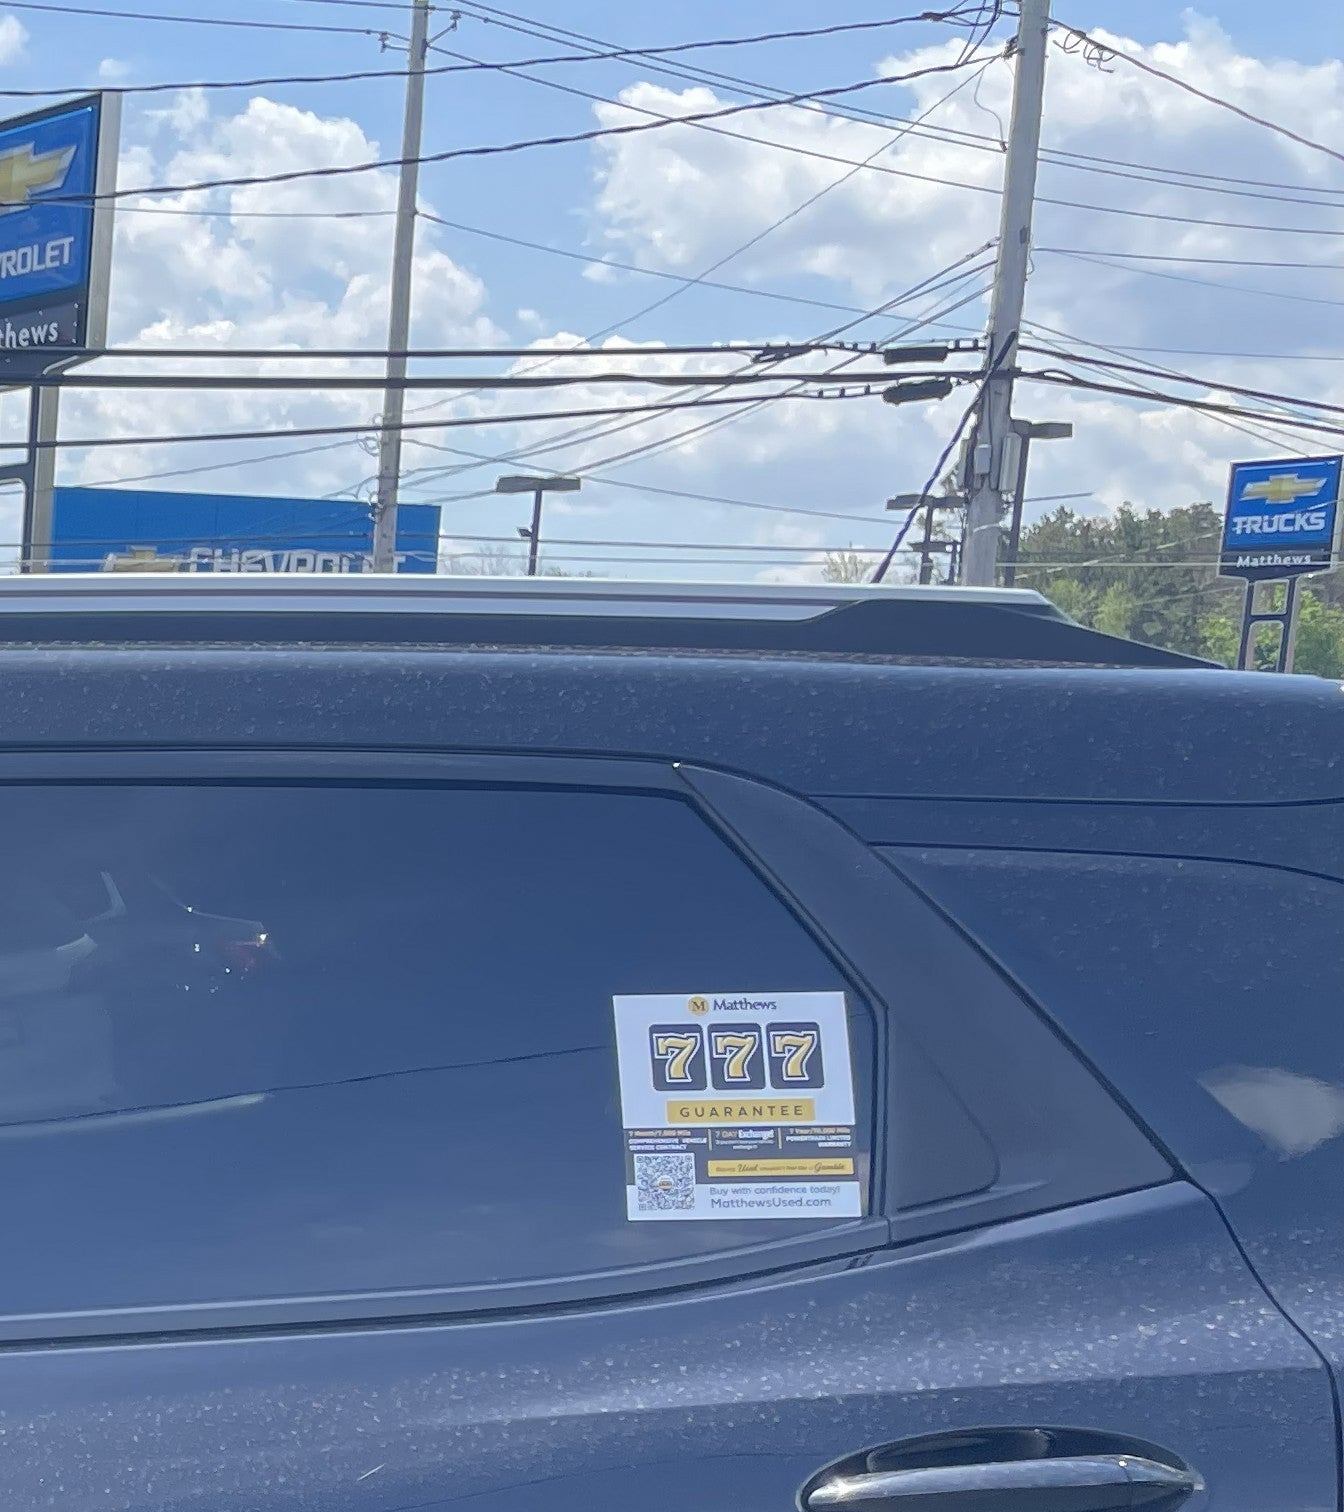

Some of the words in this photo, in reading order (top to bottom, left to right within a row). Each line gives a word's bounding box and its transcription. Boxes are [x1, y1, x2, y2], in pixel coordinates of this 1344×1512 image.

[1232, 511, 1326, 535] TRUCKS
[1237, 554, 1311, 568] Matthews
[713, 997, 777, 1012] Matthews
[679, 1104, 804, 1118] GUARANTEE
[709, 1186, 729, 1197] Buy
[731, 1186, 752, 1195] with
[754, 1185, 807, 1194] confidence
[711, 1197, 831, 1208] MatthewsUsed.com
